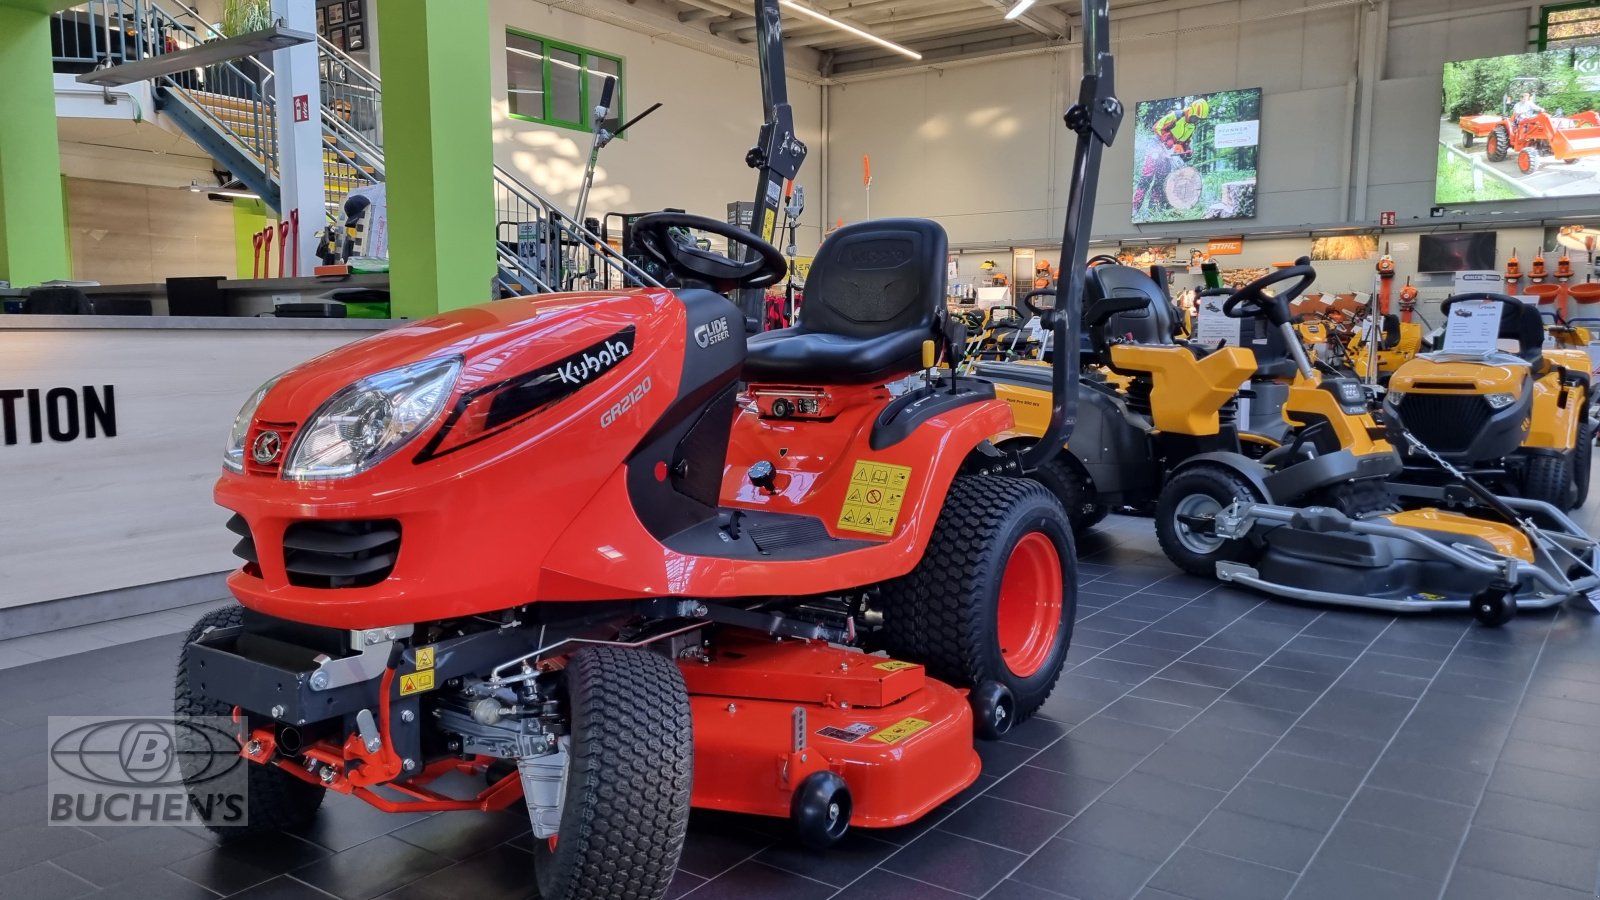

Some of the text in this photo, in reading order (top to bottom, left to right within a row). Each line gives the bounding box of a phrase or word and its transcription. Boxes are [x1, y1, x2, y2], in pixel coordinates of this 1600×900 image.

[1574, 59, 1600, 72] Ku
[1210, 242, 1237, 250] STIHL
[694, 316, 728, 349] GLIDE
[709, 330, 730, 345] STEER
[557, 340, 630, 384] Kubota
[0, 384, 117, 446] TION
[600, 376, 652, 429] GR2120
